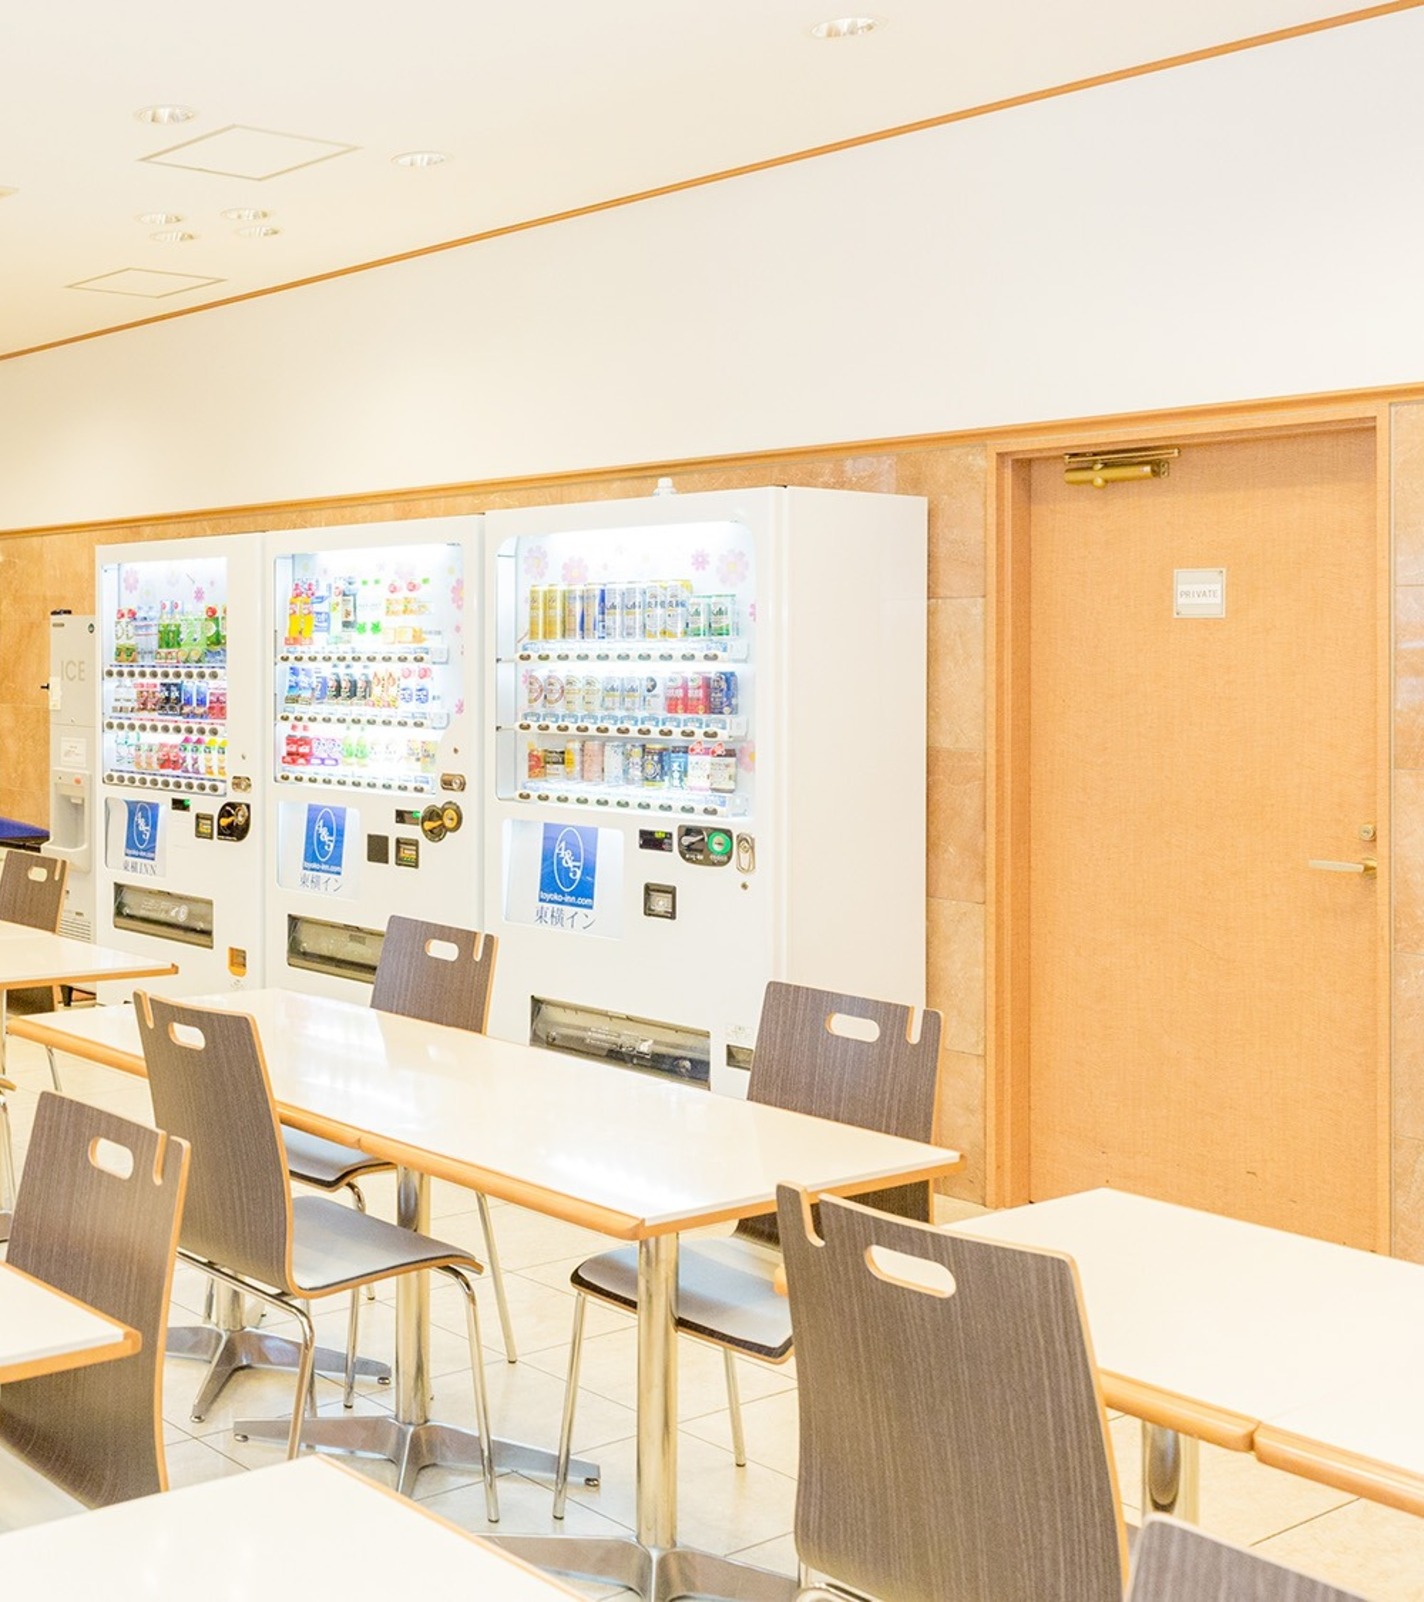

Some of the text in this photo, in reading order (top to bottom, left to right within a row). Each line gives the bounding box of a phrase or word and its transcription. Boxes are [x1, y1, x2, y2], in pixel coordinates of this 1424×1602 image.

[1179, 589, 1218, 599] PRIVATE
[60, 660, 86, 682] ICE
[300, 872, 343, 892] 東横イン
[539, 891, 594, 906] toyoko-inn.com
[535, 905, 597, 930] 東横イン
